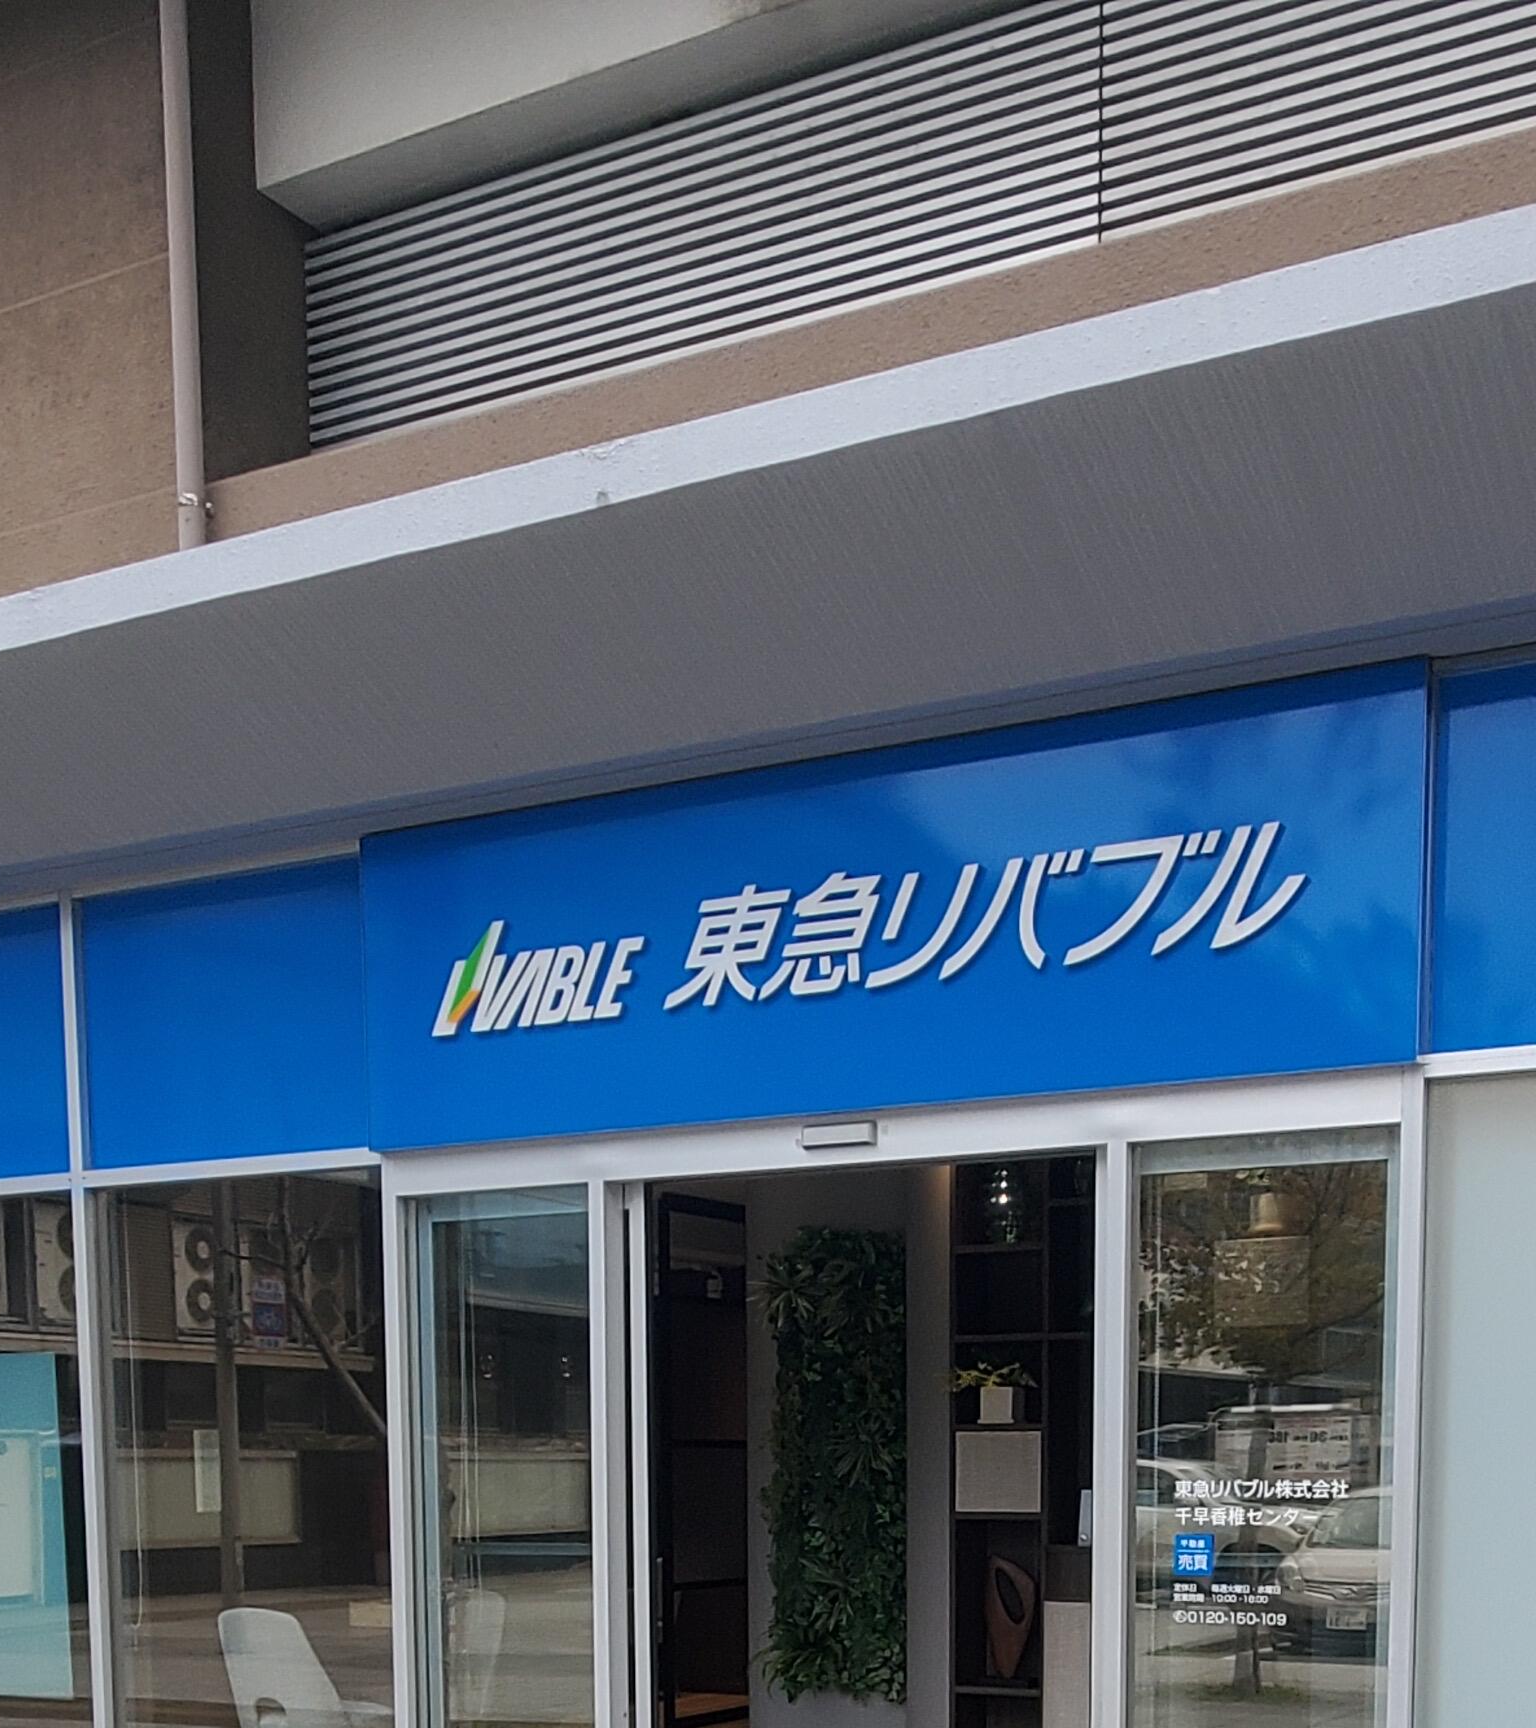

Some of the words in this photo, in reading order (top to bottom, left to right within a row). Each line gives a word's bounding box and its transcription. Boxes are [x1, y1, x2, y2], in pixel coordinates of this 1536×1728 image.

[663, 820, 1307, 1011] 東急リバブル
[1174, 1479, 1349, 1499] 東急リバブル株式会社
[1174, 1507, 1319, 1526] 千早香椎センター
[1177, 1554, 1208, 1571] 売買
